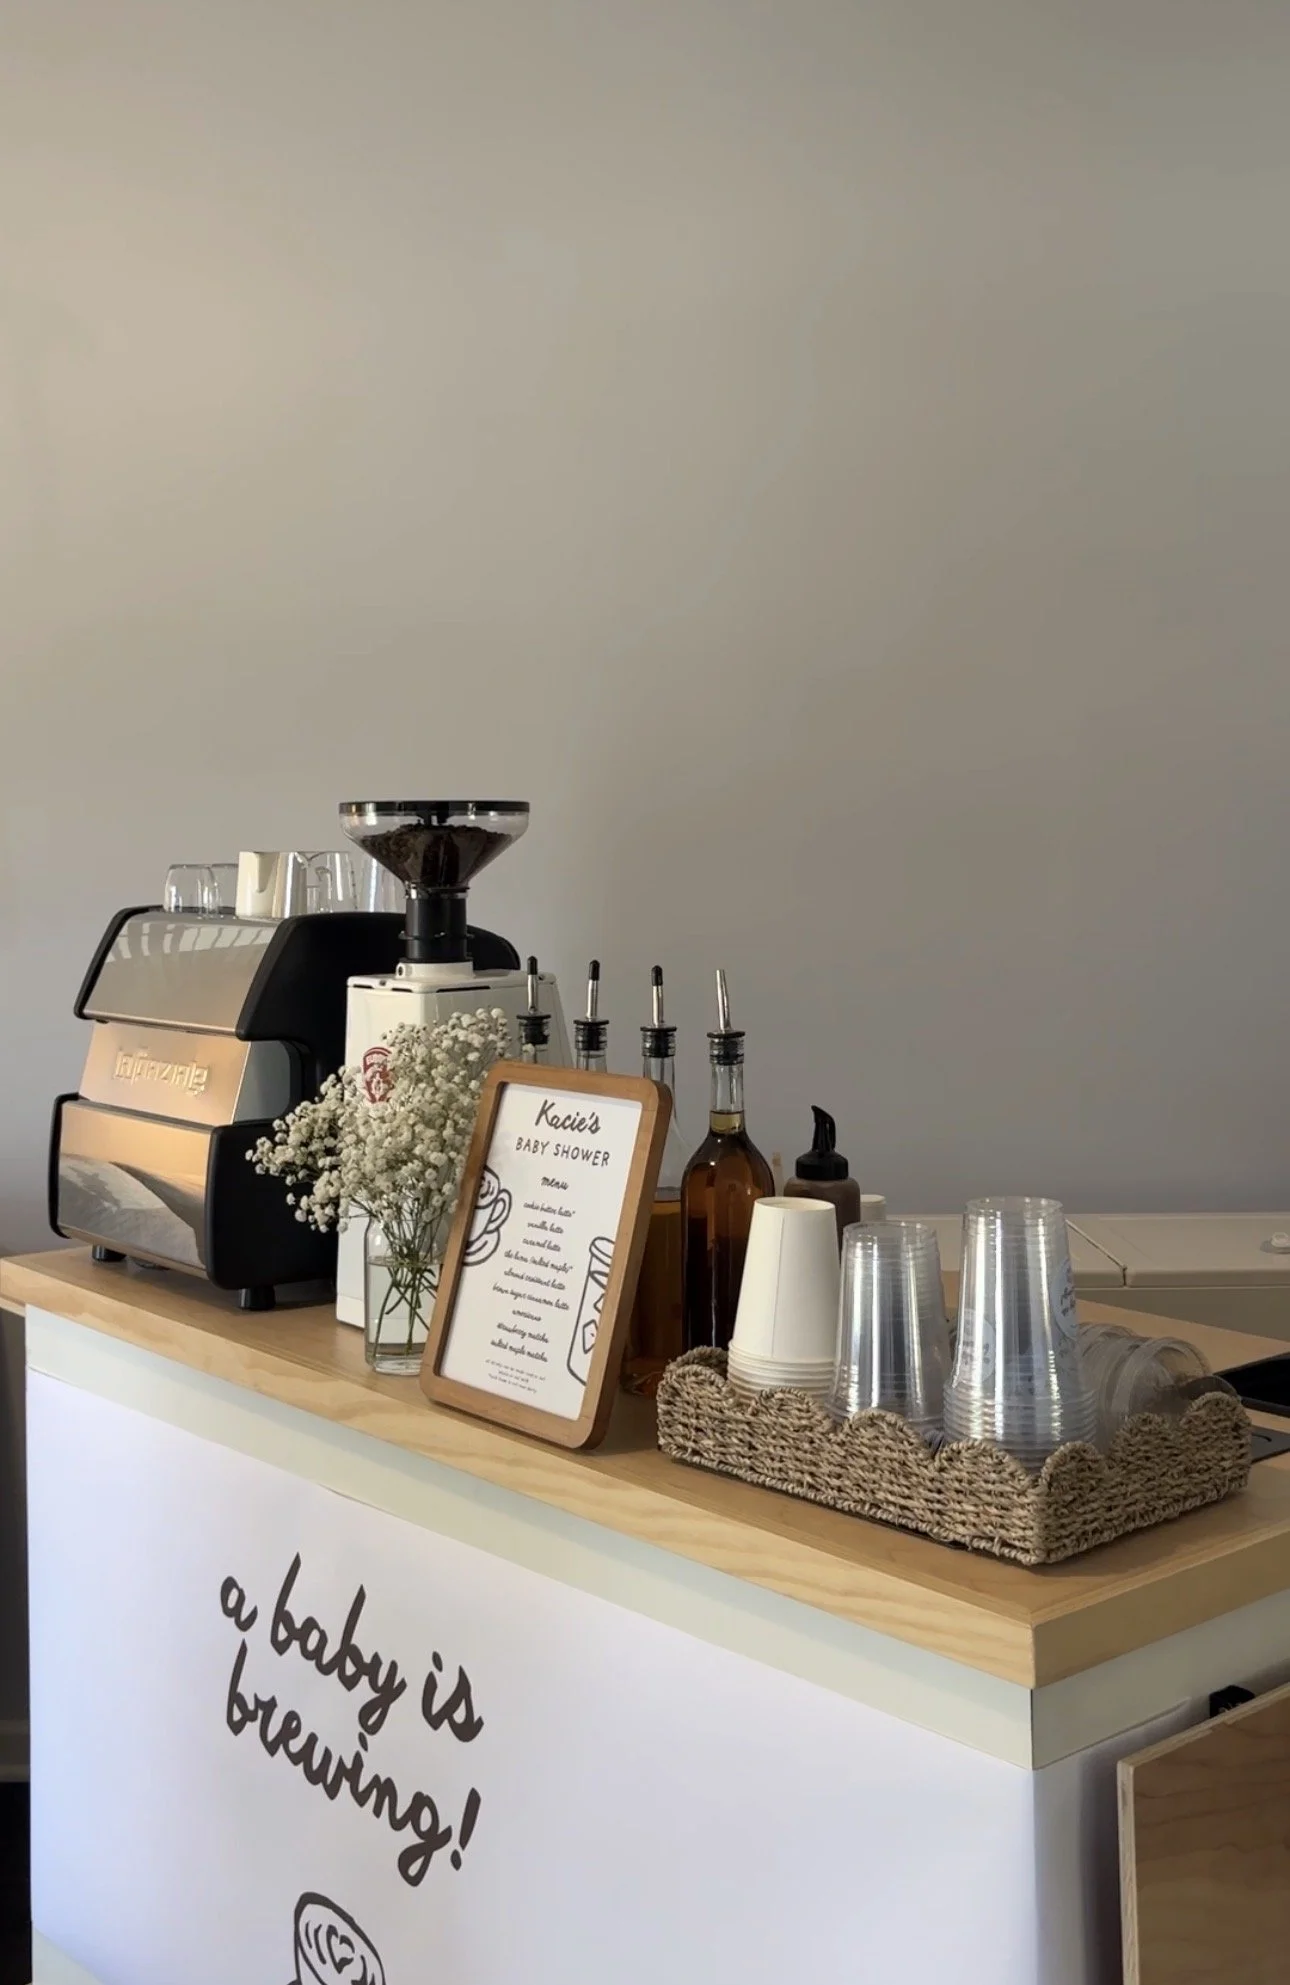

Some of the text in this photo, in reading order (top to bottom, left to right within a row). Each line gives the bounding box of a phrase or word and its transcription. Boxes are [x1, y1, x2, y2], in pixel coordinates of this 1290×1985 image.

[535, 1099, 601, 1134] Kacie's
[515, 1136, 610, 1167] BABY SHOWER
[540, 1176, 569, 1190] menu
[527, 1220, 564, 1234] vanilla latte
[522, 1238, 561, 1252] caramel latte
[504, 1267, 525, 1279] almond
[551, 1279, 566, 1290] latte
[492, 1282, 509, 1294] brown
[509, 1289, 527, 1300] sugar
[554, 1298, 570, 1310] latte
[497, 1322, 549, 1343] strawberry matcha
[490, 1338, 548, 1362] salted maple matcha
[220, 1551, 484, 1743] a baby is
[226, 1638, 482, 1887] brewing!
